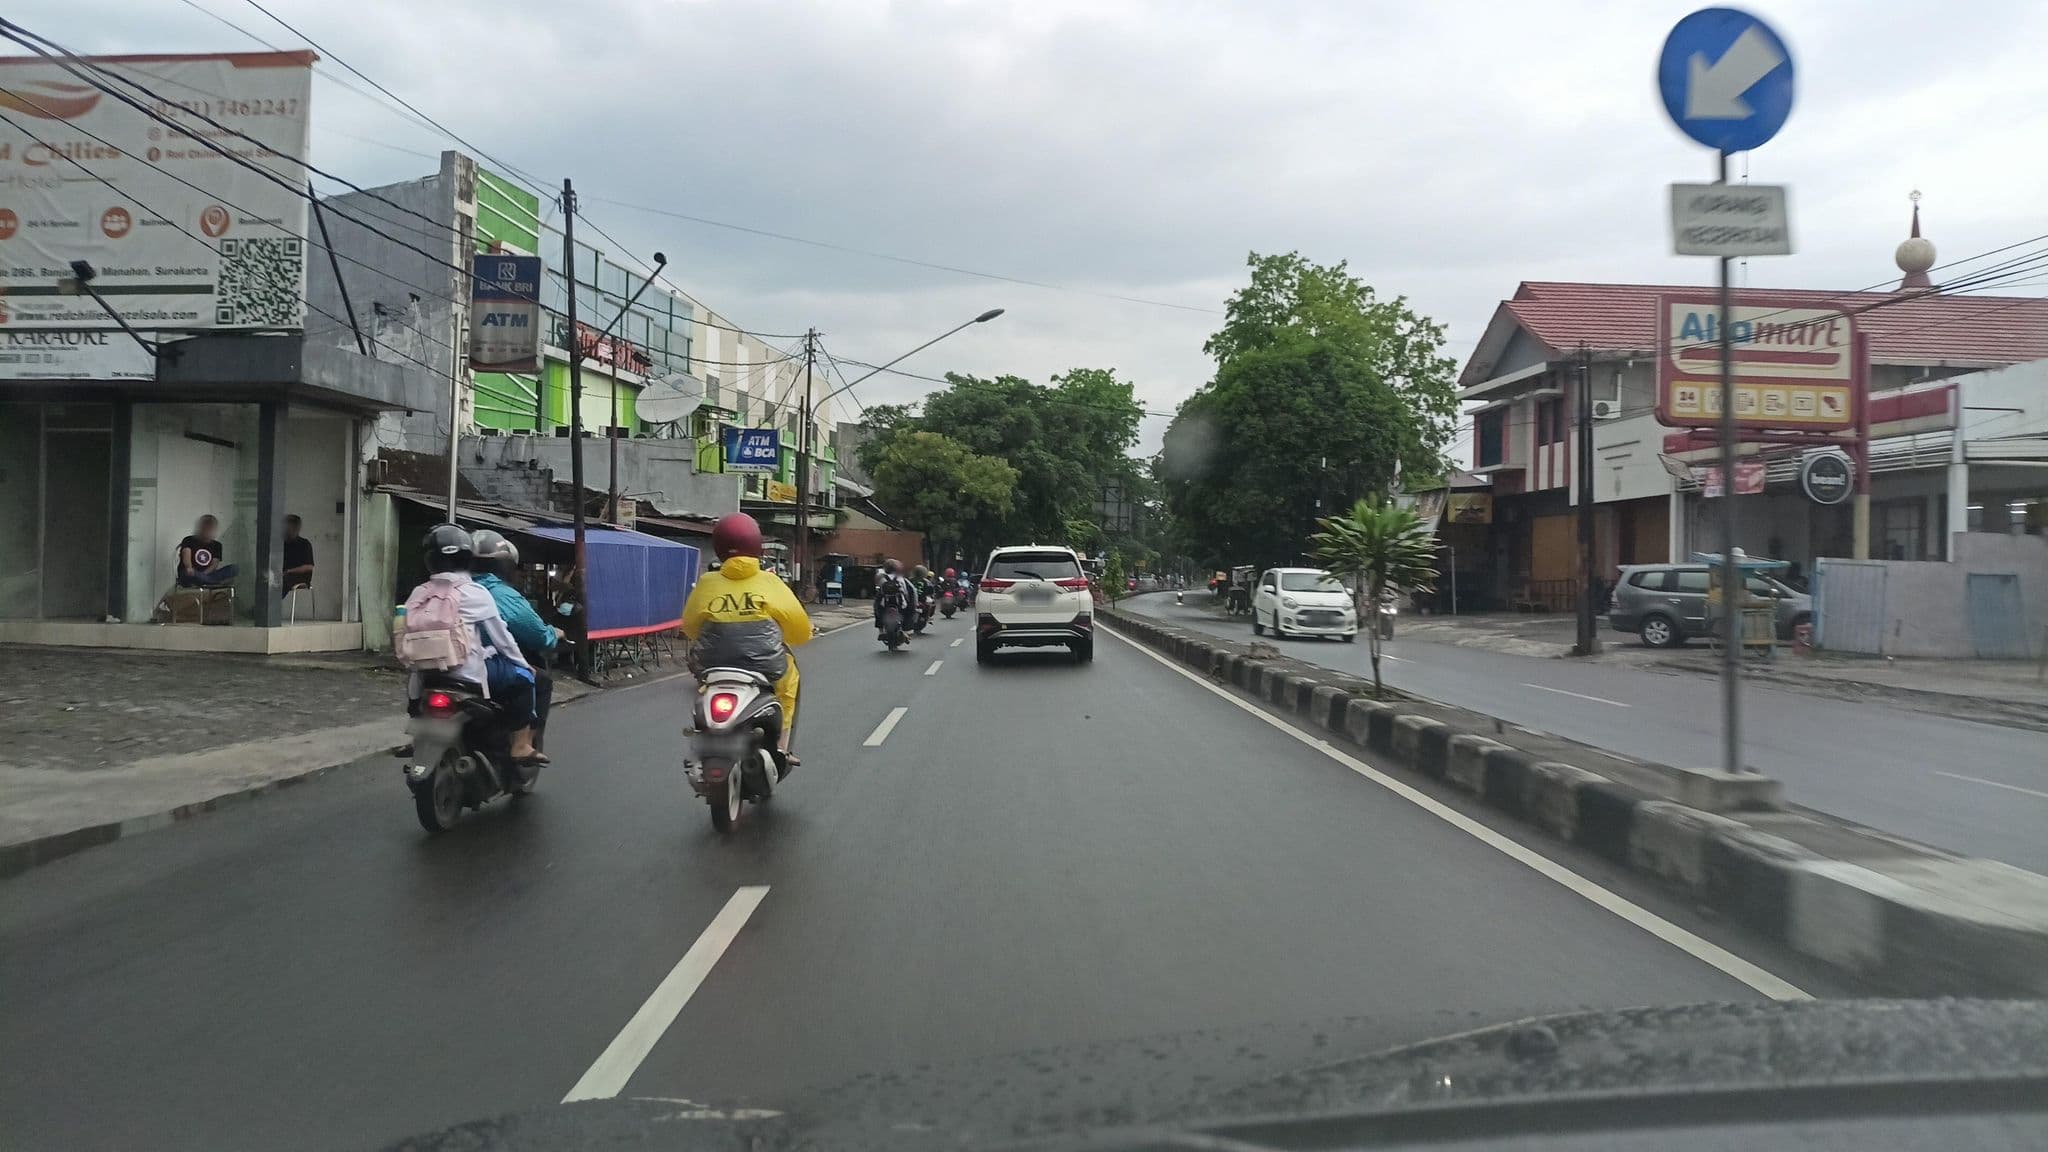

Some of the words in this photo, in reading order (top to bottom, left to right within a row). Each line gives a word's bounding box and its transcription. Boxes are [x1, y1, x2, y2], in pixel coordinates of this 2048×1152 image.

[155, 265, 208, 277] Surakarta
[480, 280, 511, 293] BANK
[514, 281, 533, 293] BRI
[15, 309, 199, 321] www.redchiliesotelsolo.com
[481, 312, 529, 329] ATM
[1679, 312, 1841, 347] Alamart
[8, 332, 109, 346] KARAOKE
[1679, 390, 1695, 401] 24
[748, 435, 770, 446] ATM
[754, 447, 776, 458] BCA
